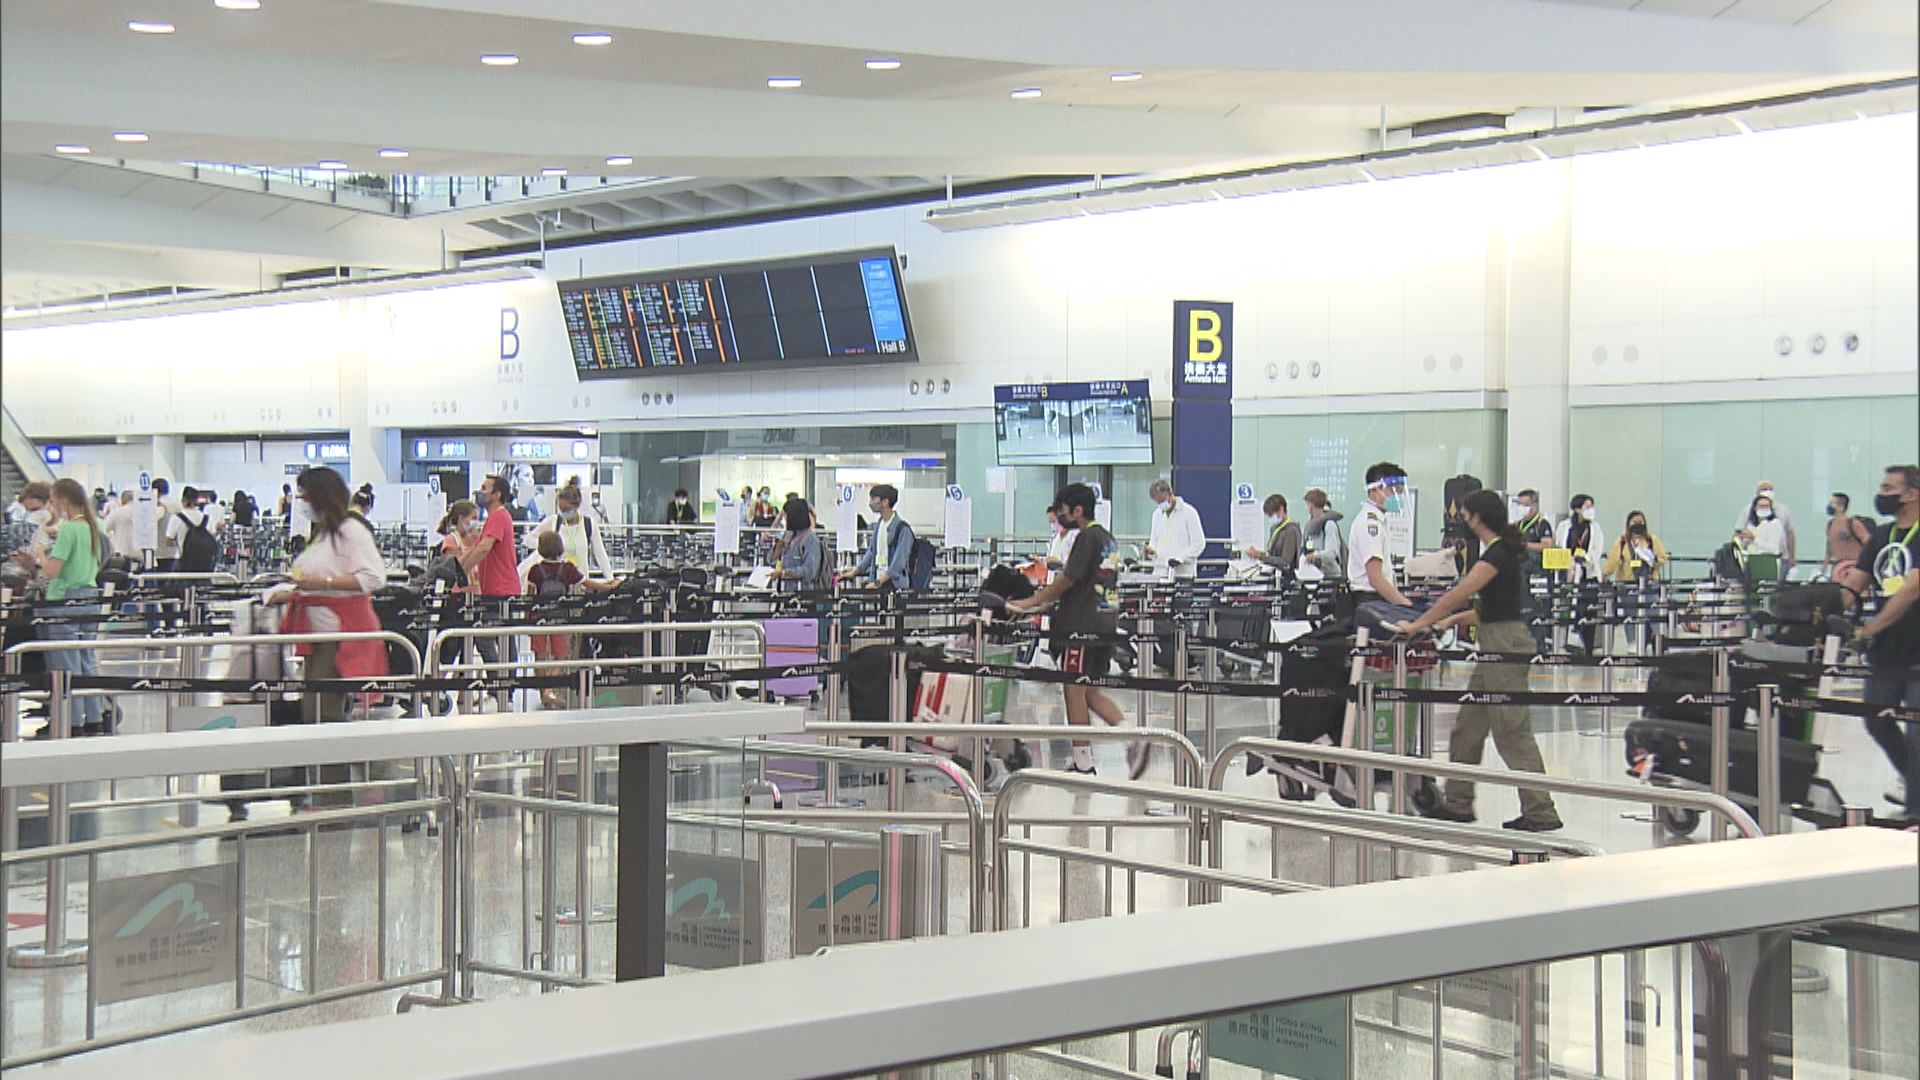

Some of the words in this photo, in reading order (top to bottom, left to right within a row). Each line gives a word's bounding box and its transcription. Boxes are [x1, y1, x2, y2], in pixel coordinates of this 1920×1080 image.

[501, 307, 520, 360] B
[1189, 309, 1223, 362] B
[881, 341, 898, 353] Hall
[899, 339, 906, 352] B
[1184, 374, 1211, 384] Arrivals
[1213, 374, 1227, 384] Hall
[1041, 386, 1048, 398] B
[1120, 382, 1129, 395] A
[140, 476, 149, 487] 11
[1241, 486, 1249, 498] 3
[1275, 1015, 1298, 1028] HONG
[1299, 1022, 1323, 1034] KONG
[1275, 1026, 1339, 1048] INTERNATIONAL
[1275, 1037, 1309, 1050] AIRPORT
